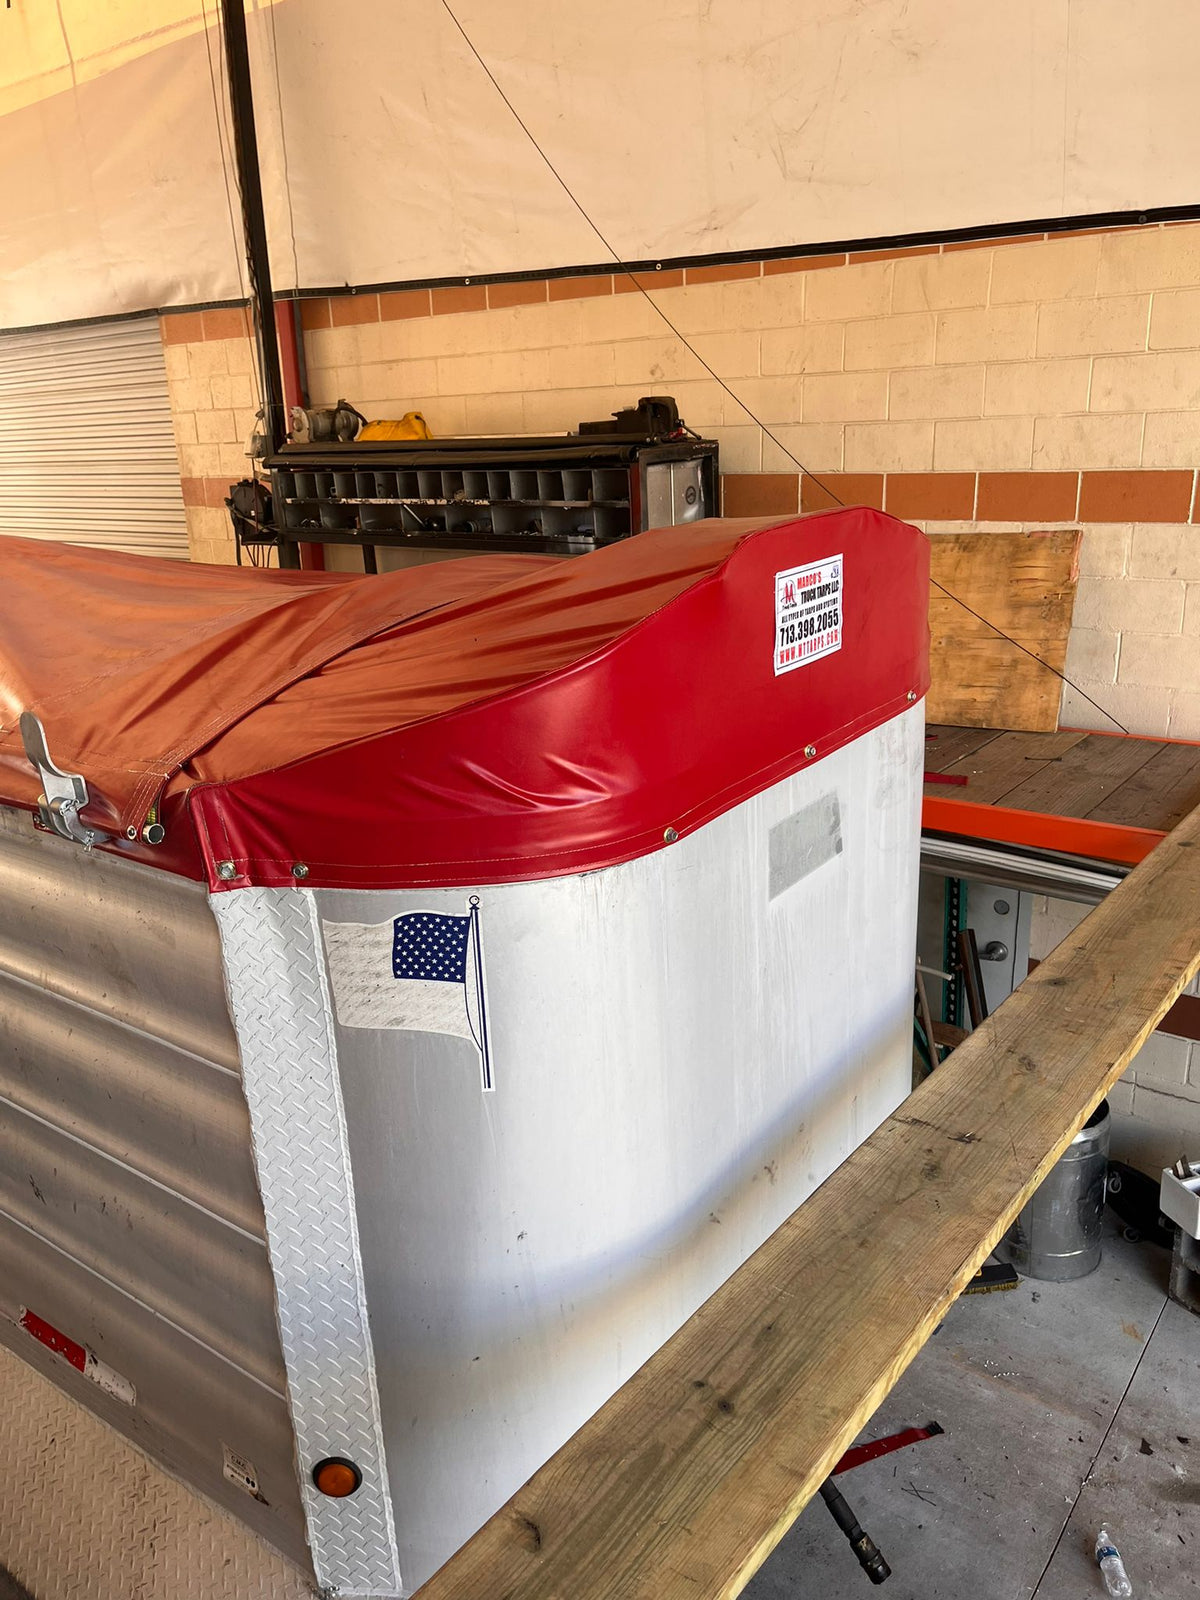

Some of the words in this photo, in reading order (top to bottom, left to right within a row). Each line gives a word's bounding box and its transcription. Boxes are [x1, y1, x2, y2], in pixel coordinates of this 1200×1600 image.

[797, 571, 822, 590] MARCO'S
[801, 587, 816, 604] TRUCK
[817, 582, 831, 599] TARPS
[780, 608, 839, 647] 713.398.2055
[780, 628, 839, 664] WWW.MTTARPS.COM
